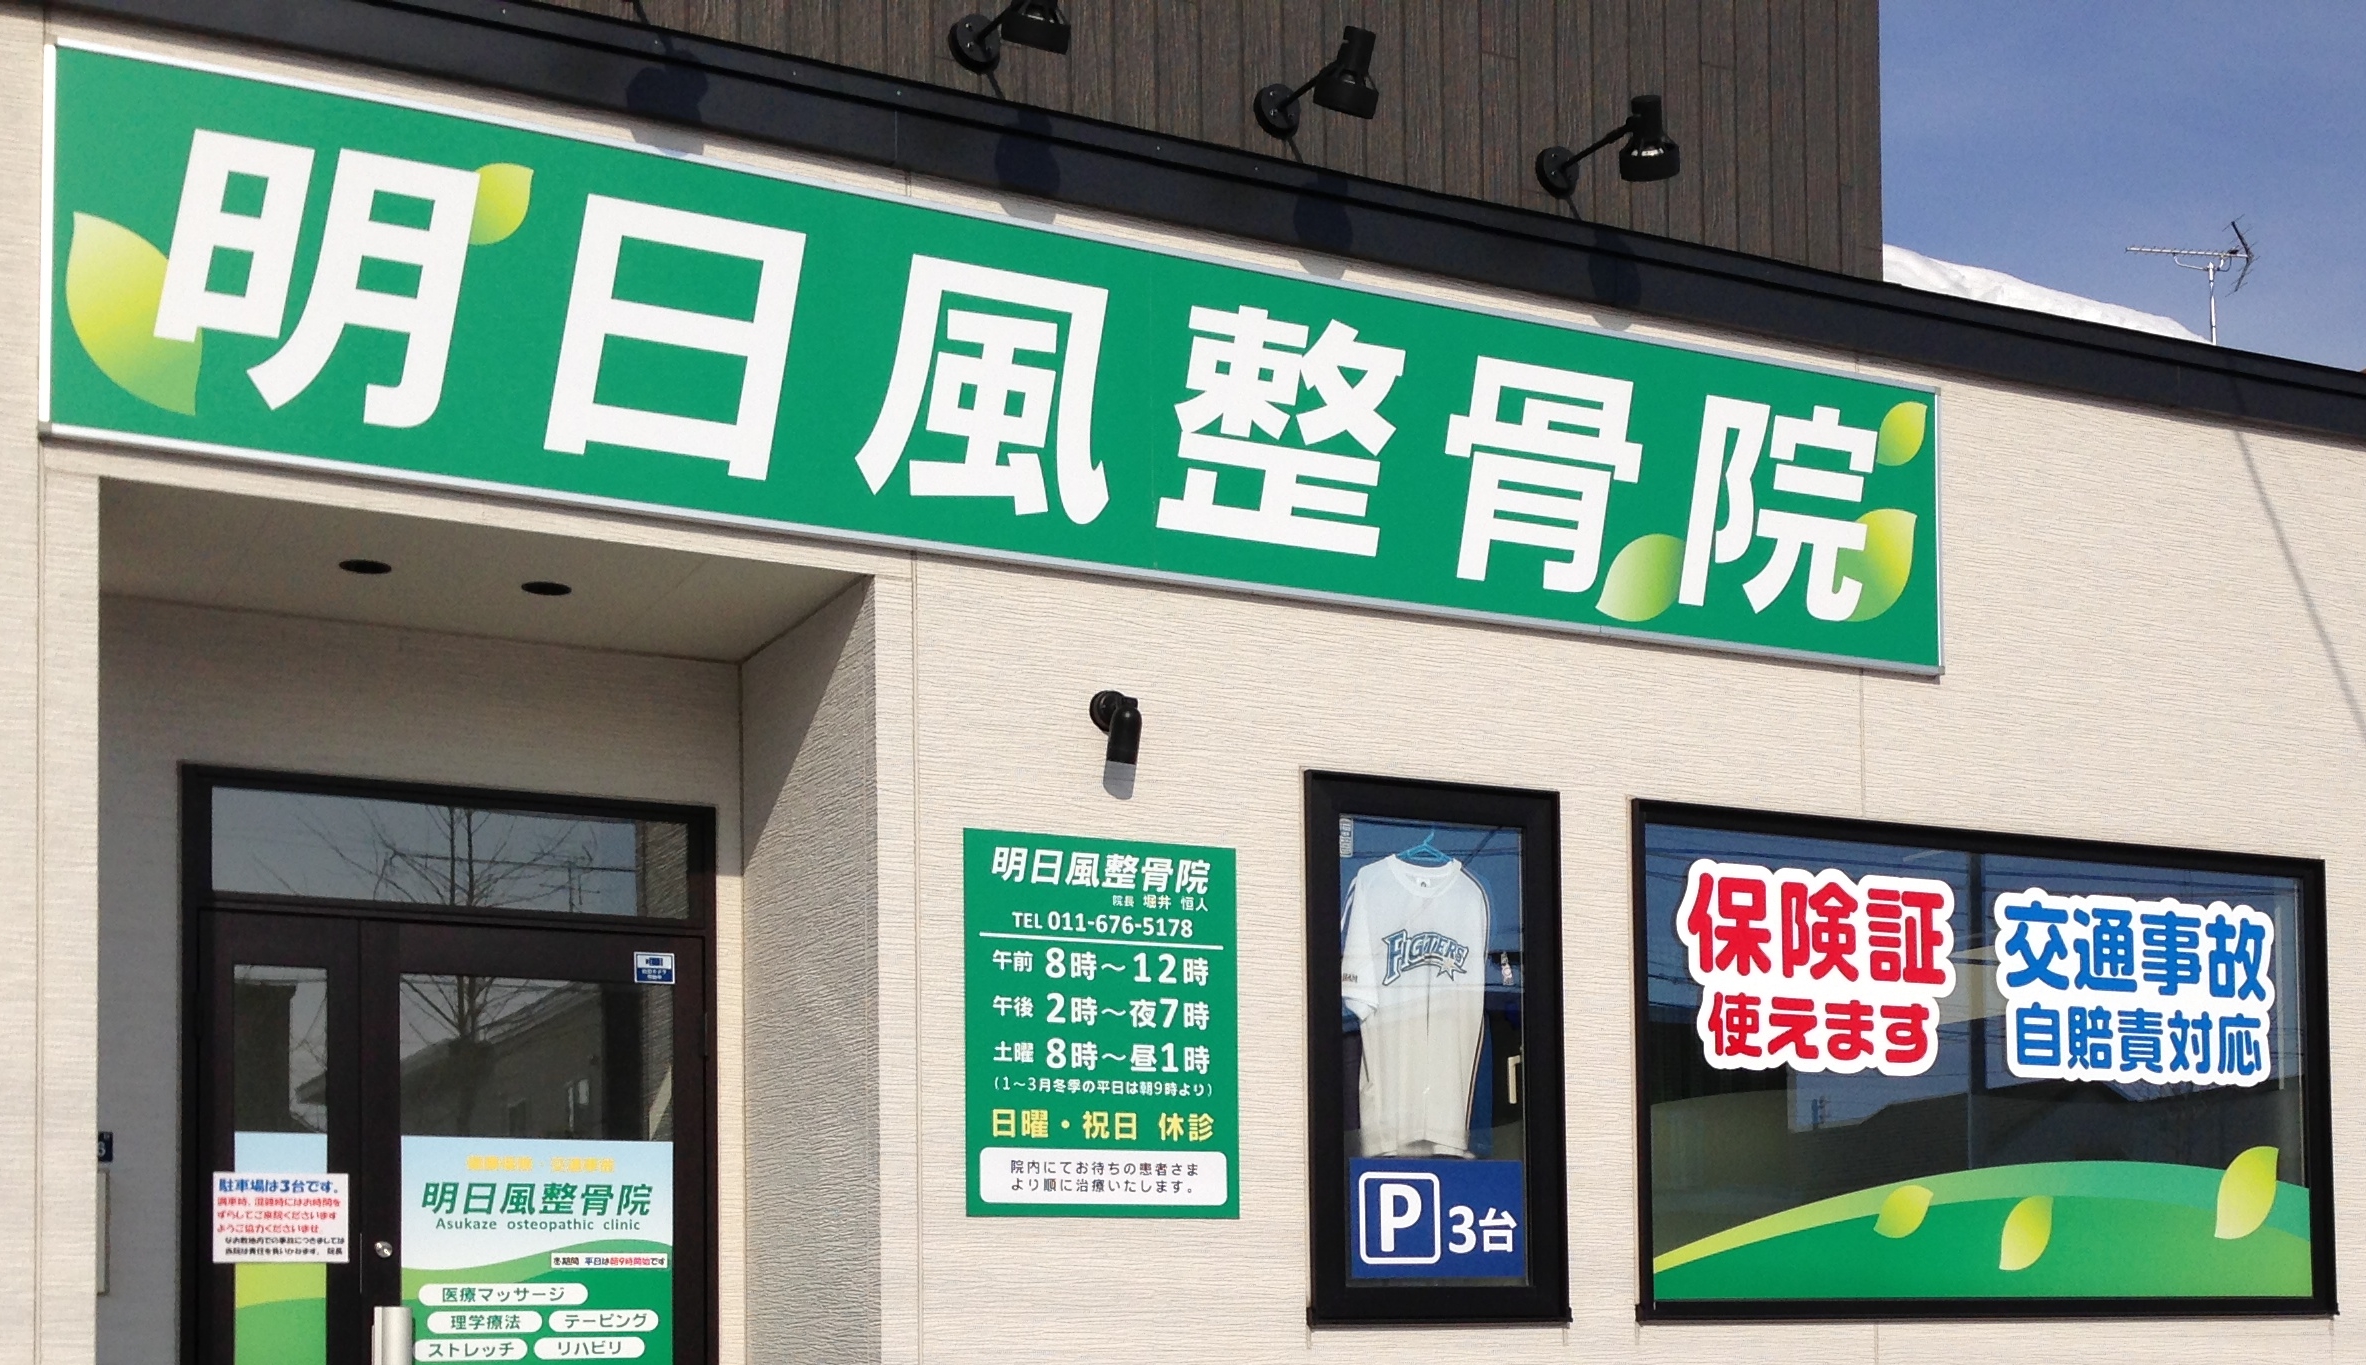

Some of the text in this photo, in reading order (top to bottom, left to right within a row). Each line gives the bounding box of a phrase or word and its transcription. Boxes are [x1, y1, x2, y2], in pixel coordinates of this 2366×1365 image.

[153, 128, 1878, 622] 明日風整骨院
[991, 846, 1212, 895] 明日風整骨院
[1112, 894, 1135, 909] 院長
[1012, 910, 1194, 938] TEL 011-676-5178
[1687, 872, 1946, 986] 保険証
[992, 949, 1034, 973] 午前
[2005, 900, 2266, 1001] 交通事故
[992, 995, 1034, 1018] 午後
[1707, 991, 1930, 1064] 使えます
[2015, 1002, 2263, 1076] 自賠責対応
[993, 1040, 1034, 1064] 土曜
[1158, 1112, 1215, 1143] 休診
[1010, 1159, 1199, 1178] 院内にてお待ちの患者さま
[1010, 1176, 1194, 1195] より順に治療いたします。
[421, 1181, 654, 1217] 明日風整骨院
[435, 1217, 641, 1233] Asukaze osteopathic clinic
[1379, 1183, 1518, 1254] P 3台
[441, 1286, 566, 1304] 医療マッサージ
[450, 1314, 522, 1331] 理学療法
[564, 1313, 648, 1329] テーピング
[428, 1341, 515, 1358] ストレッチ
[557, 1340, 622, 1356] リハビリ
